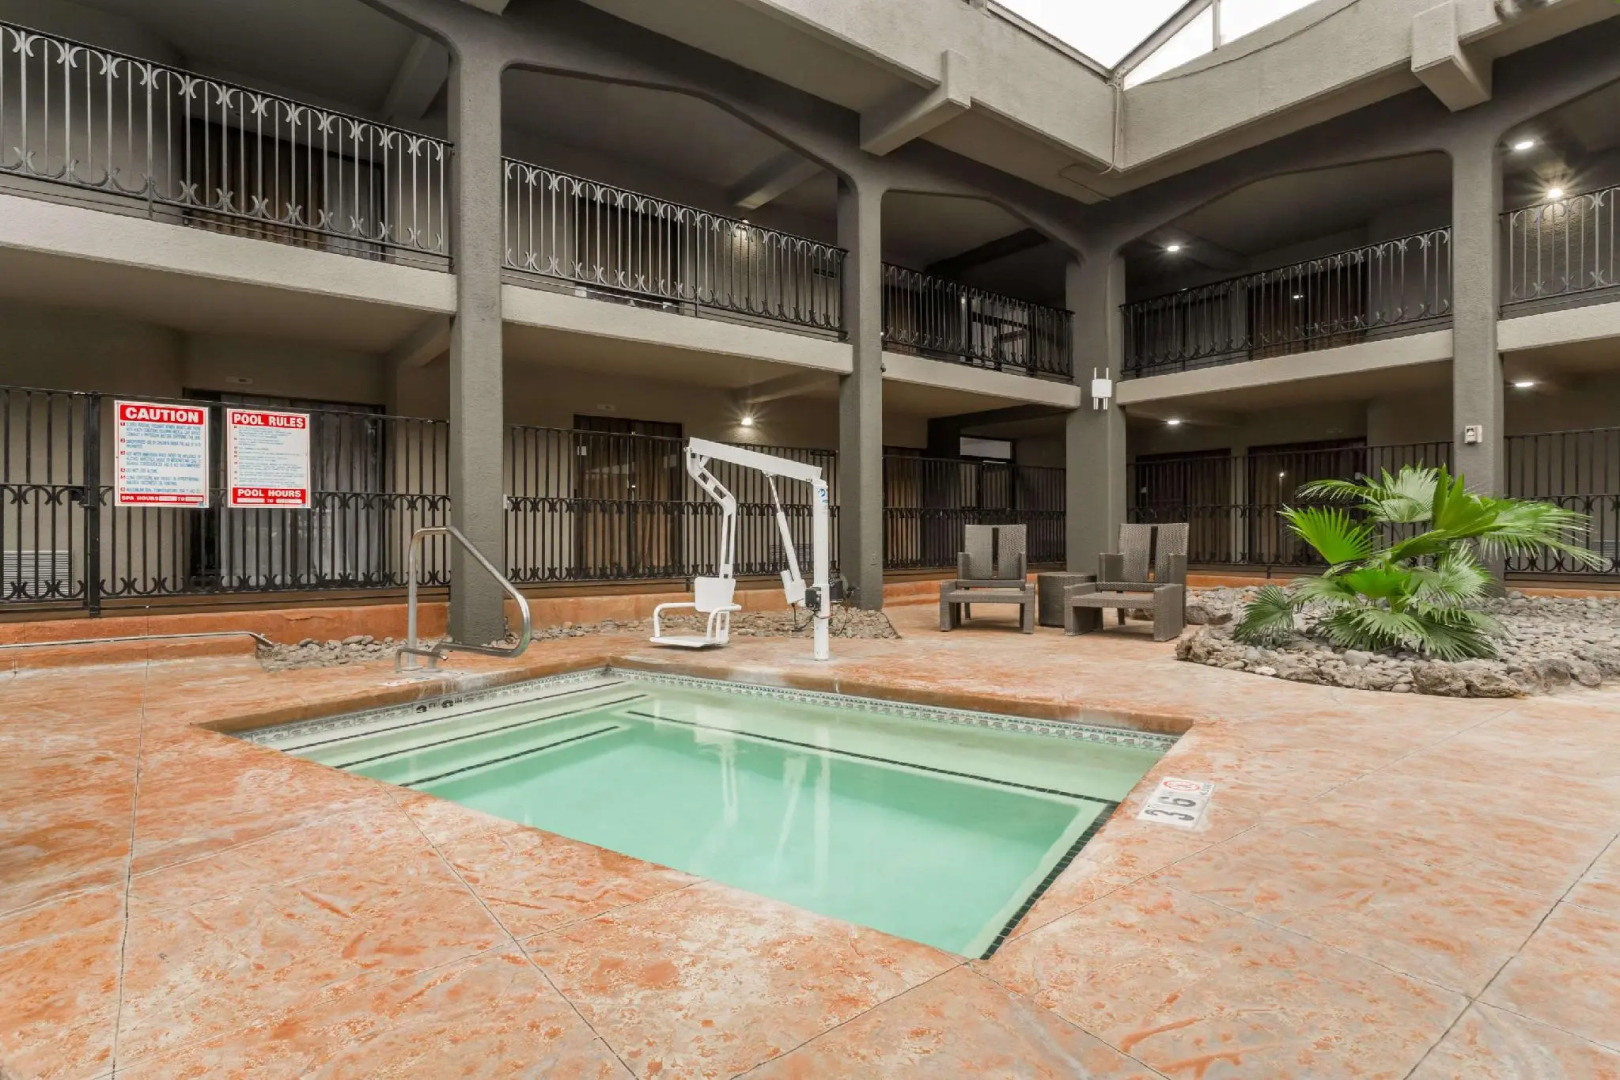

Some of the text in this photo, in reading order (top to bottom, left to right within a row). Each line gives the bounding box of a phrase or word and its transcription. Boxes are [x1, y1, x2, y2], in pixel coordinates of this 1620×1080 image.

[125, 407, 199, 423] CAUTION
[233, 413, 304, 428] POOL RULES
[237, 488, 301, 498] POOL HOURS
